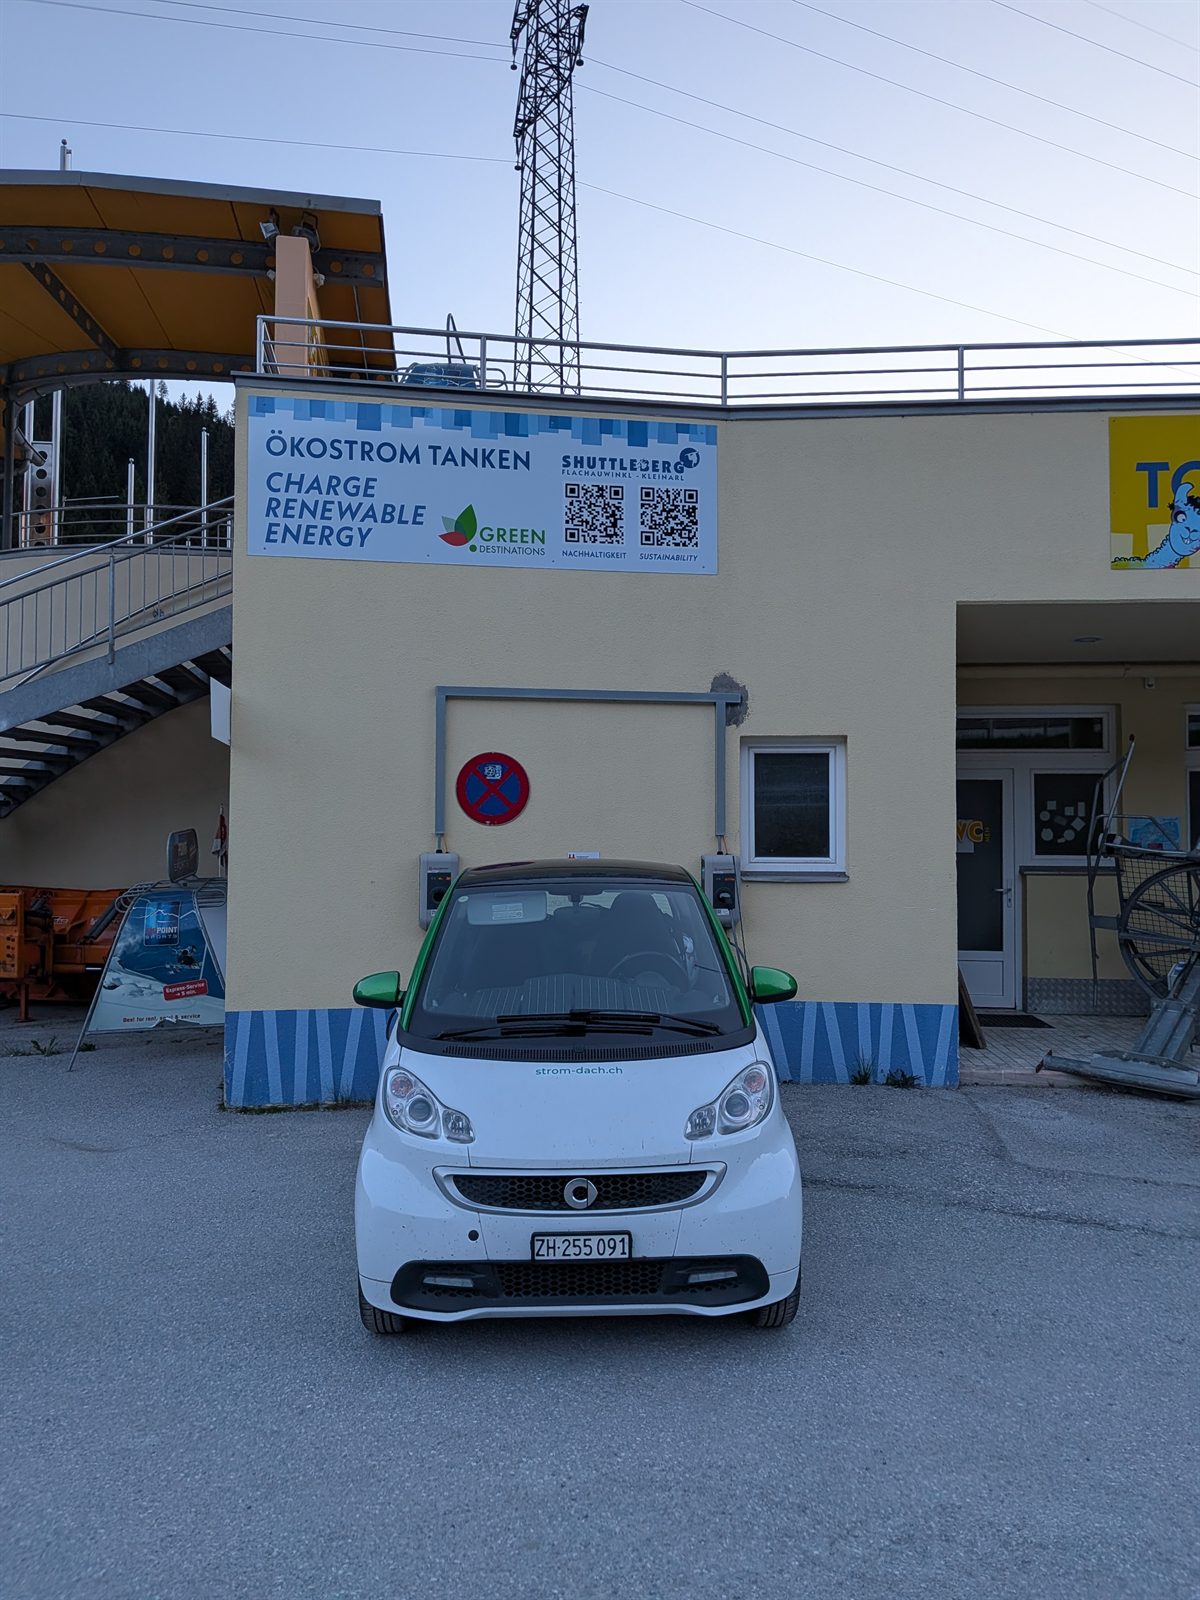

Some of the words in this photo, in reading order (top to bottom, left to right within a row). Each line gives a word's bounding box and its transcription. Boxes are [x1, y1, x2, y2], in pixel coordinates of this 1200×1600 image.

[266, 429, 421, 465] ÖKOSTROM
[428, 445, 531, 471] TANKEN
[562, 469, 632, 479] FLACHAUWINKL
[642, 473, 685, 481] KLEINARL
[266, 472, 378, 498] CHARGE
[265, 497, 426, 526] RENEWABLE
[265, 522, 373, 548] ENERGY
[479, 526, 546, 545] GREEN
[479, 545, 546, 556] DESTINATIONS
[562, 550, 627, 559] NACHHALTIGKEIT
[639, 553, 698, 562] SUSTAINABILITY
[535, 1066, 623, 1075] strom-dach.ch
